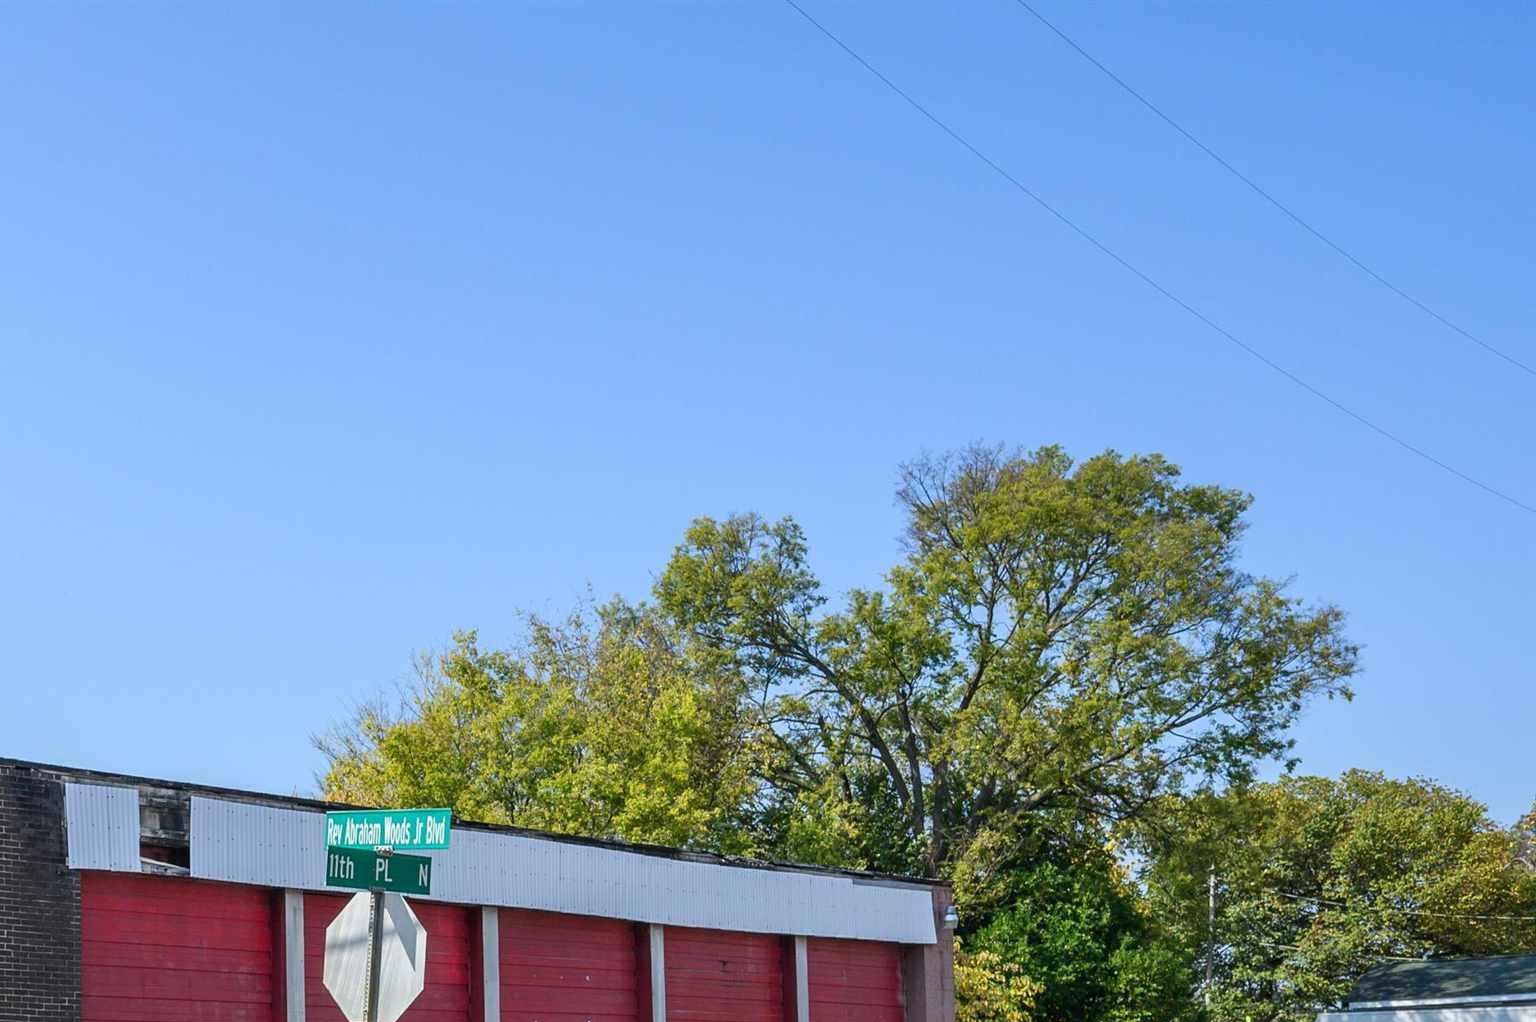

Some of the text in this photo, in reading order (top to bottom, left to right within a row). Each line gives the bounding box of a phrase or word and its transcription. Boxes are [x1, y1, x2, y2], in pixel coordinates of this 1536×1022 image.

[327, 815, 446, 845] Rev Abraham Woods Jr Blvd
[329, 854, 429, 887] 11th PL N
